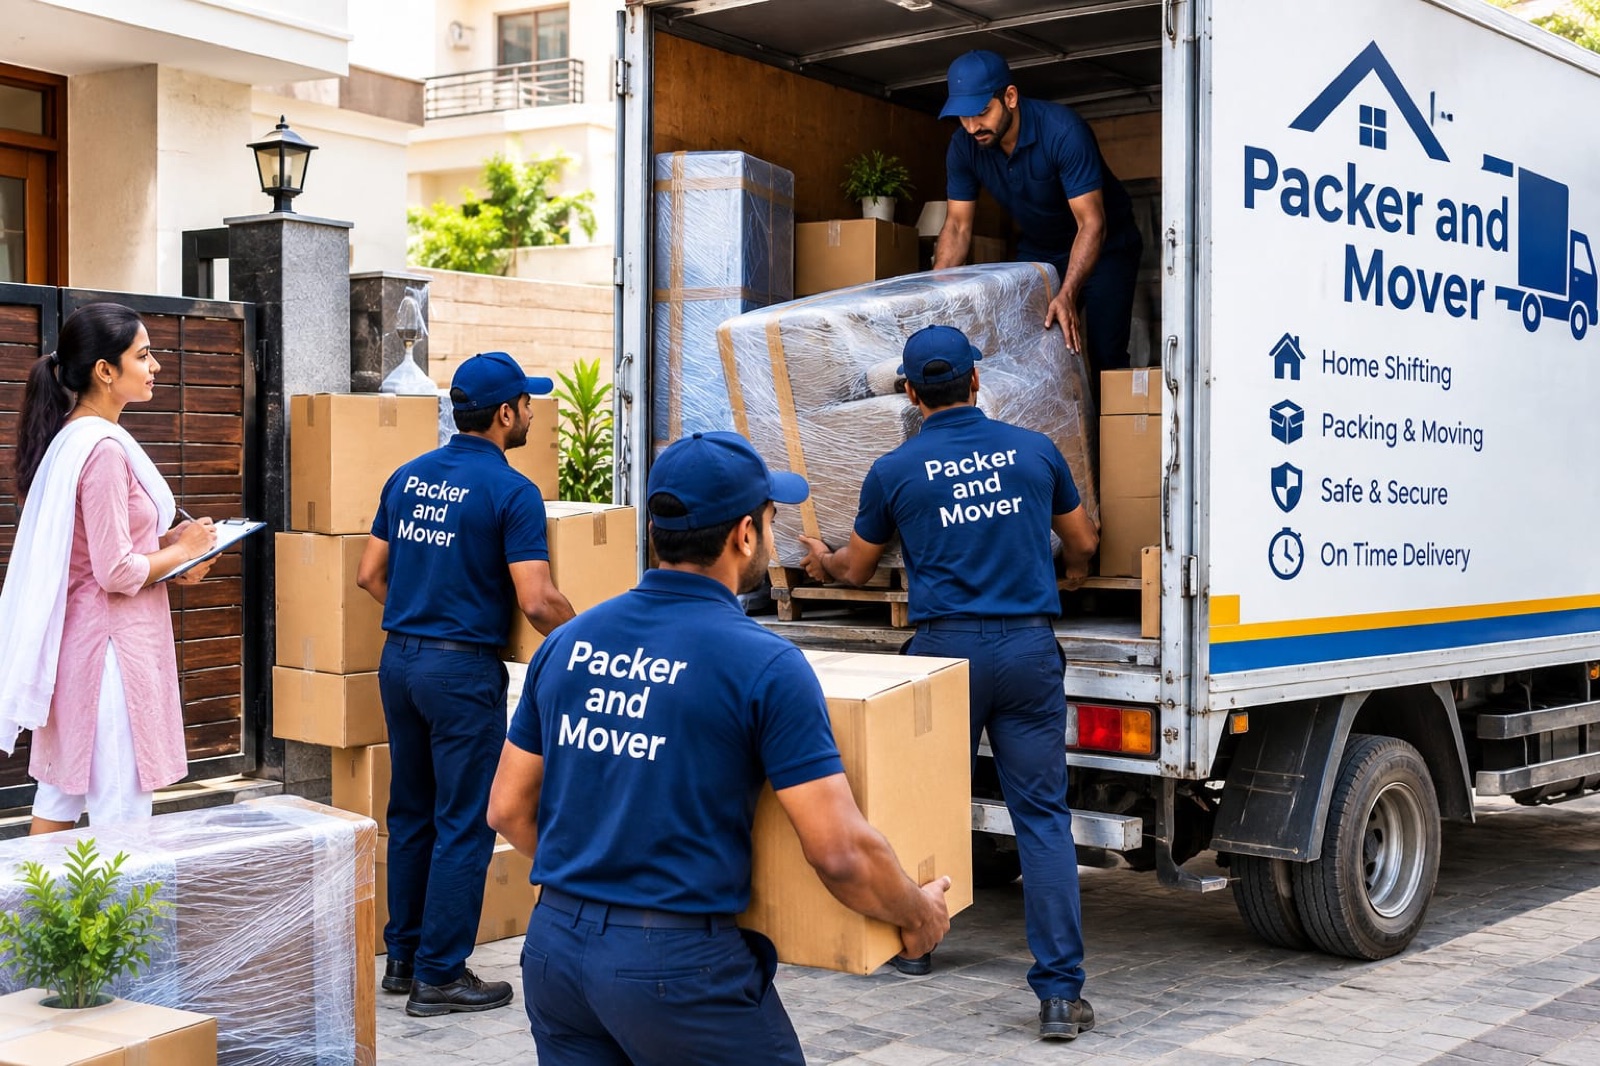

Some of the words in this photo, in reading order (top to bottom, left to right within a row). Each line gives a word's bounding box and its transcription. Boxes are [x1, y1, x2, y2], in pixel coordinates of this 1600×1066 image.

[1244, 145, 1423, 236] Packer
[1436, 196, 1508, 252] and
[1344, 243, 1485, 320] Mover
[1322, 349, 1379, 378] Home
[1385, 355, 1452, 390] Shifting
[1322, 413, 1397, 448] Packing
[1403, 418, 1416, 442] &
[1421, 420, 1483, 452] Moving
[924, 449, 1017, 481] Packer
[403, 476, 469, 503] Packer
[953, 471, 1001, 499] and
[1321, 478, 1363, 503] Safe
[1369, 480, 1382, 503] &
[1387, 480, 1448, 505] Secure
[412, 503, 449, 523] and
[939, 496, 1022, 527] Mover
[397, 519, 455, 547] Mover
[1320, 542, 1347, 567] On
[1353, 542, 1397, 566] Time
[1403, 543, 1470, 572] Delivery
[567, 640, 688, 685] Packer
[585, 686, 650, 719] and
[558, 714, 666, 761] Mover
